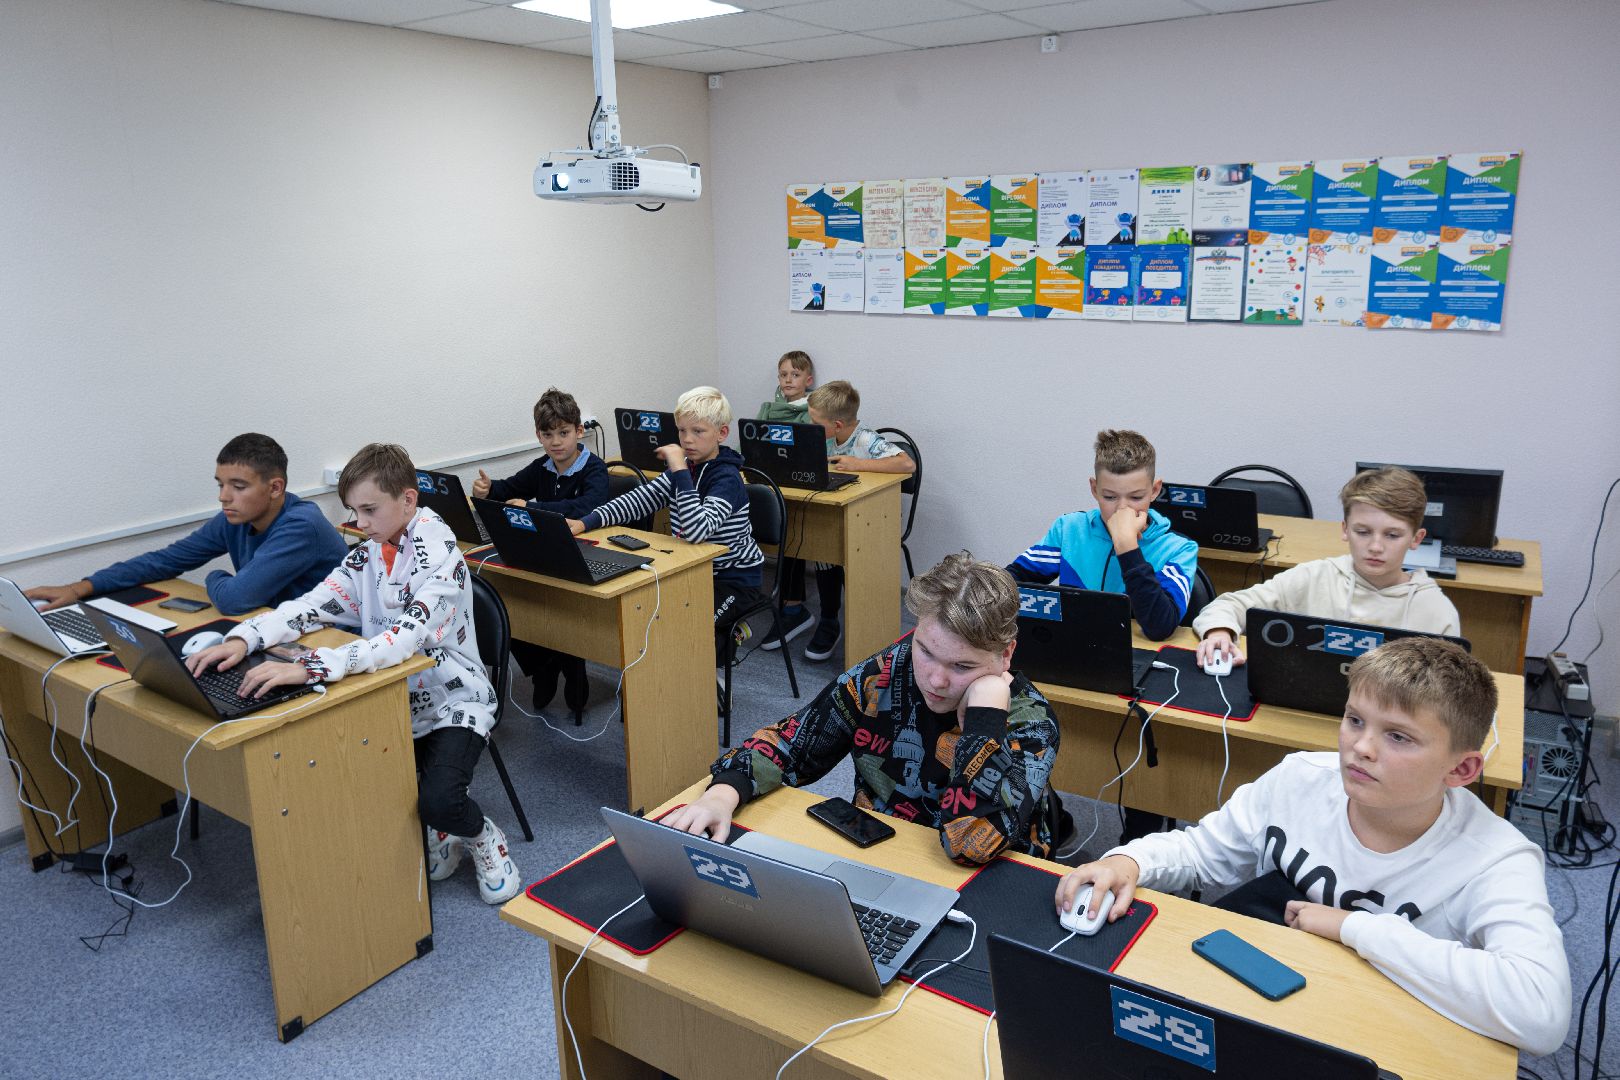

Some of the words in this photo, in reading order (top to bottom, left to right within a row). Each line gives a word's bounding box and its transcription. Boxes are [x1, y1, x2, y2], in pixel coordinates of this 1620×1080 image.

[1328, 181, 1363, 190] ДИПЛОМ
[1393, 178, 1430, 187] ДИПЛОМ
[1463, 176, 1501, 186] ДИПЛОМ
[1265, 184, 1298, 192] ДИПЛОМ
[1385, 265, 1422, 274] ДИПЛОМ
[1453, 264, 1491, 273] ДИПЛОМ
[640, 415, 660, 428] 23
[770, 428, 793, 442] 22
[1170, 490, 1204, 505] 21
[507, 511, 533, 527] 26
[1020, 593, 1058, 614] 27
[1327, 631, 1377, 652] 24
[690, 852, 751, 889] 29
[1118, 999, 1210, 1057] 28
